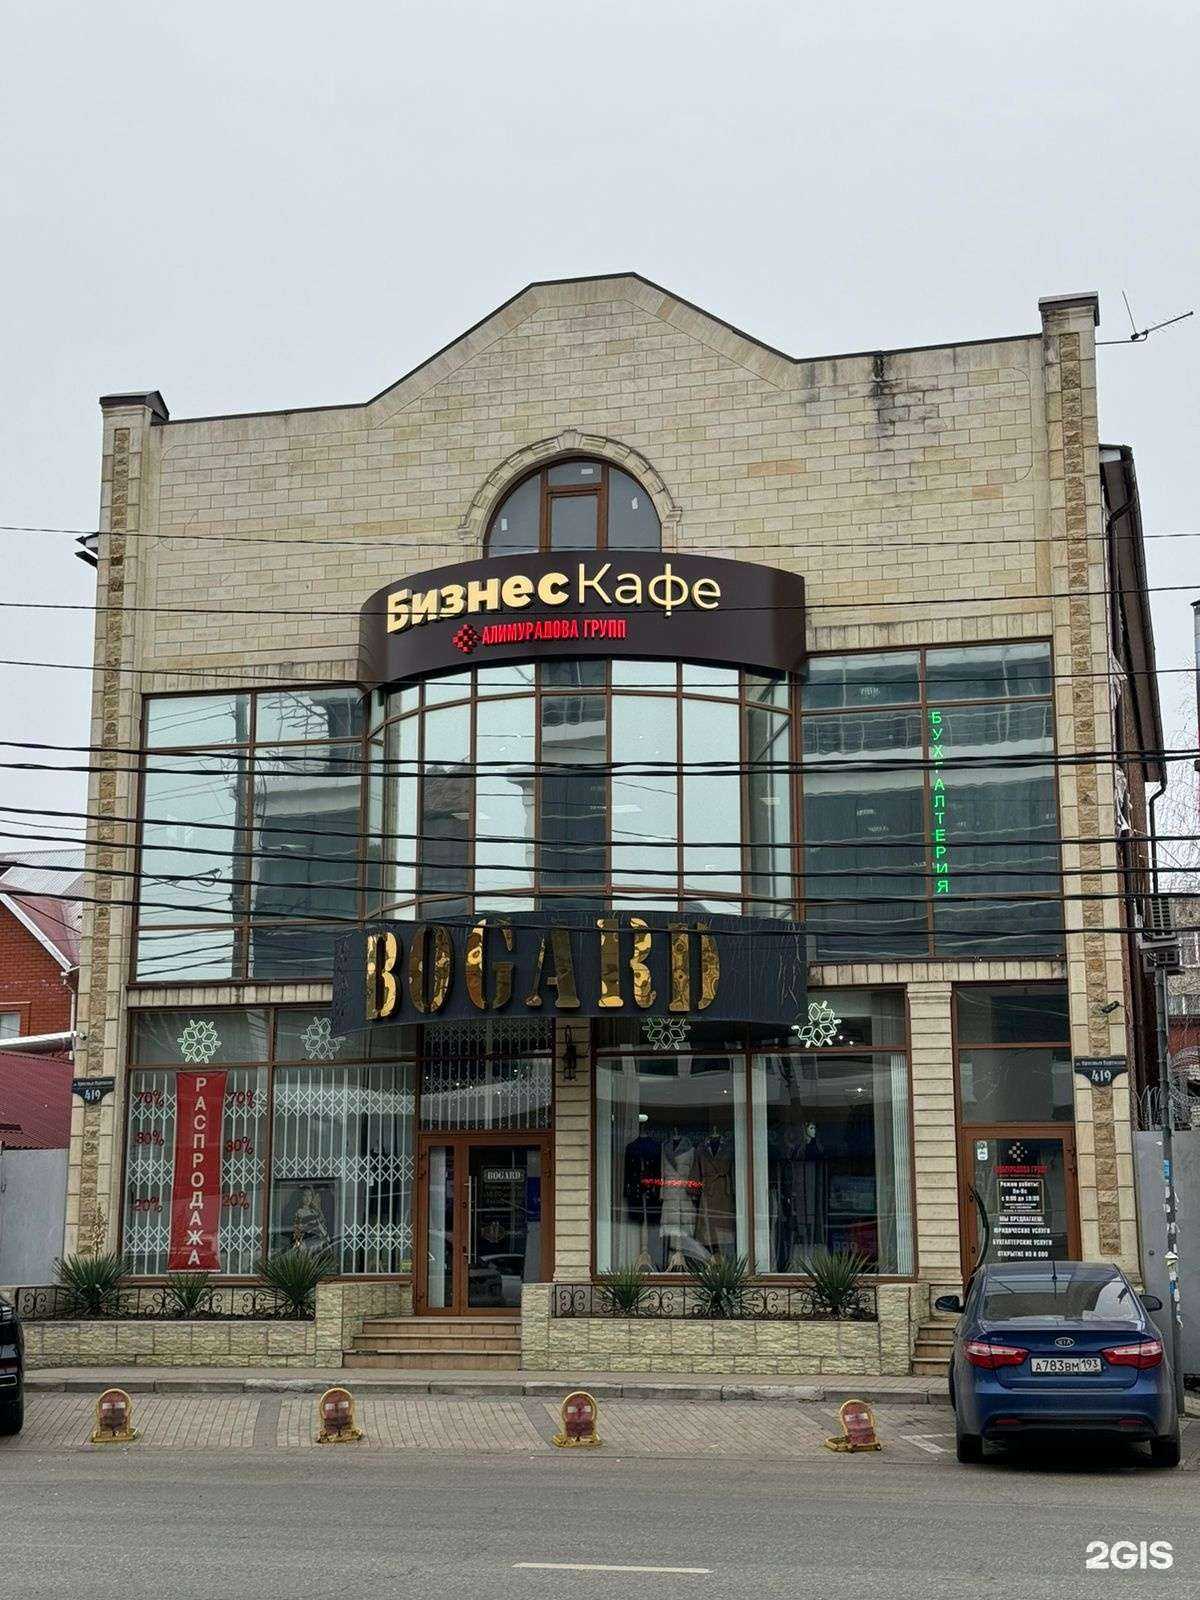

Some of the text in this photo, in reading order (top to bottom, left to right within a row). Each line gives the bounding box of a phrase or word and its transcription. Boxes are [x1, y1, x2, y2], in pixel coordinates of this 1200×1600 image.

[481, 619, 627, 645] АЛИМУРАДОВА ГРУПП
[365, 915, 721, 1020] BOGARD
[1091, 1070, 1111, 1082] 419
[84, 1089, 101, 1100] 419
[185, 1076, 207, 1266] РАСПРОДАЖА
[487, 1170, 521, 1180] BOGARD
